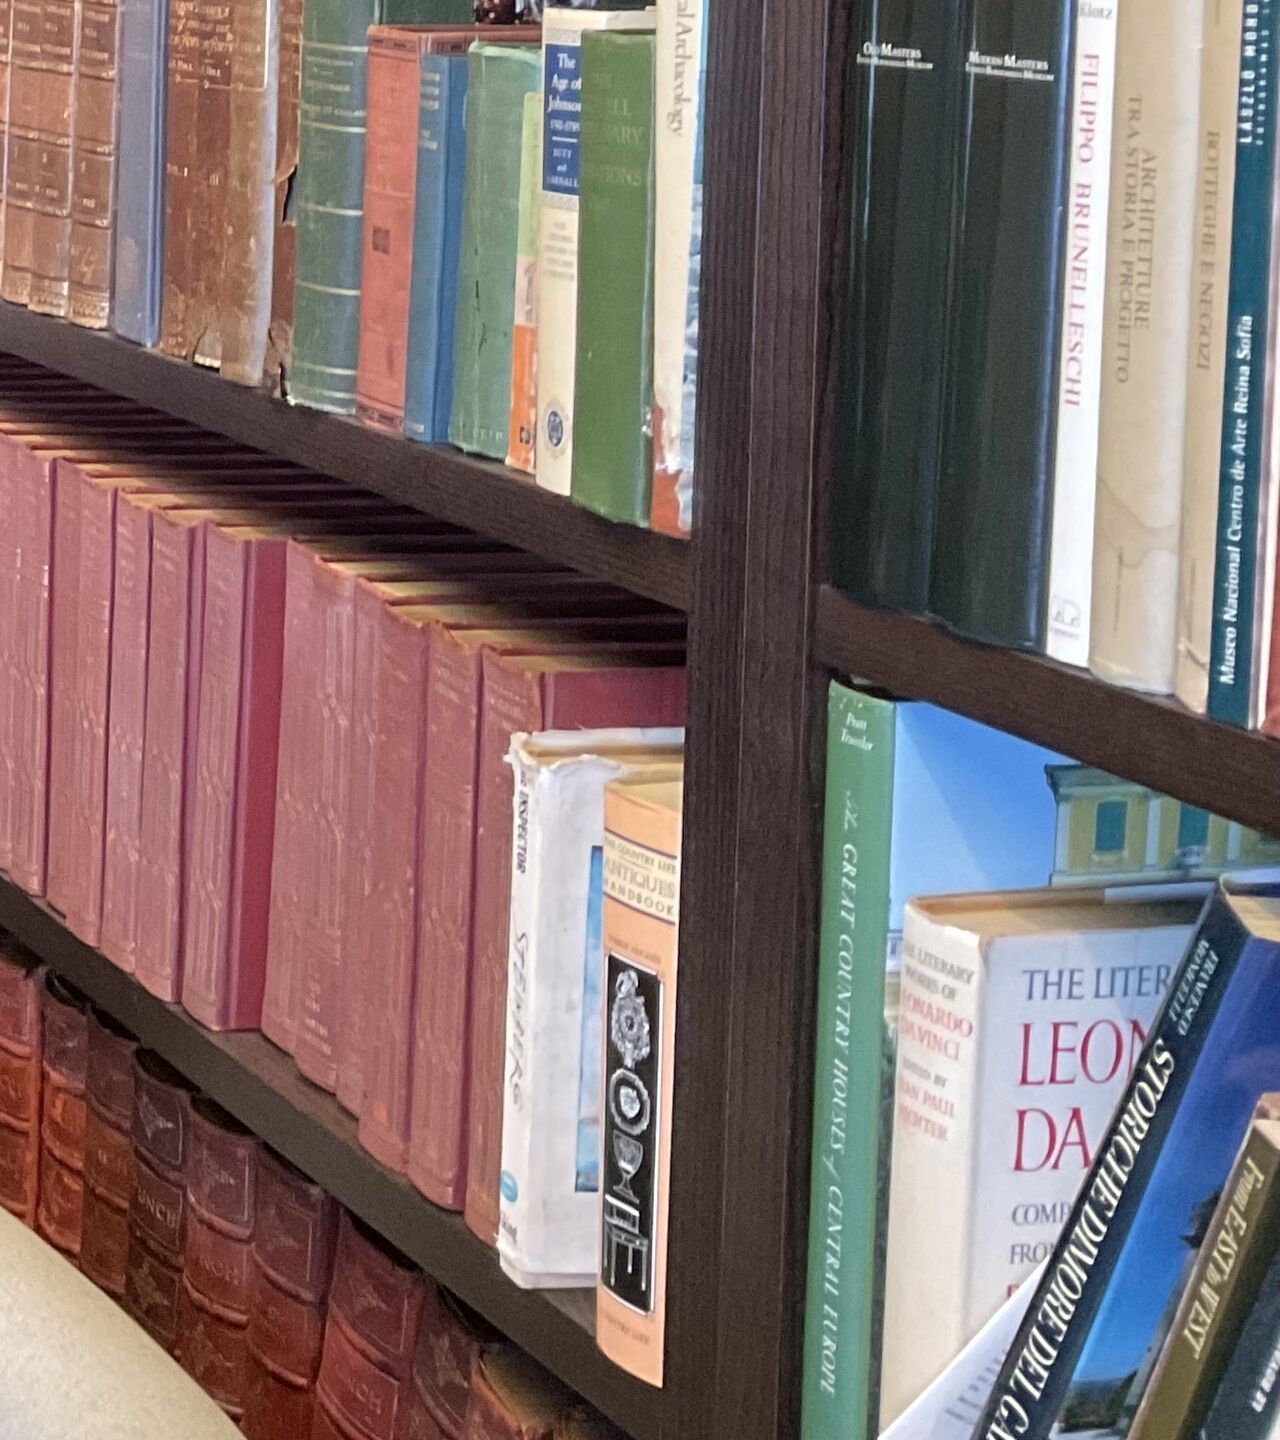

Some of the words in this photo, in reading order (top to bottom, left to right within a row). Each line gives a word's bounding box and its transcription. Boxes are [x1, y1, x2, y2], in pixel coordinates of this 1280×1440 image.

[552, 73, 570, 92] Age
[557, 53, 576, 70] The
[668, 20, 693, 137] Archaeology
[1075, 52, 1100, 164] FILIPPO
[1128, 95, 1143, 142] TRA
[1122, 145, 1139, 233] STORIA
[1201, 131, 1220, 246] BOTTEGHE
[1133, 147, 1157, 331] ARCHITETTURE
[1063, 182, 1092, 408] BRUNELLESCHI
[1116, 258, 1135, 385] PROGETTO
[1195, 279, 1214, 371] NEGOZI
[1231, 365, 1251, 415] Reina
[1226, 460, 1245, 481] de
[1228, 420, 1248, 456] Arte
[1226, 484, 1244, 541] Centro
[1218, 546, 1241, 623] Nacional
[1217, 627, 1238, 685] Museo
[516, 790, 530, 875] INSPECTOR
[838, 842, 859, 923] GREAT
[831, 933, 855, 1053] COUNTRY
[1023, 967, 1085, 1001] THE
[917, 1020, 961, 1063] VINCI
[828, 1060, 850, 1151] HOUSES
[1013, 1106, 1094, 1173] DA
[1091, 1037, 1175, 1219] STORICHE
[823, 1185, 844, 1296] CENTRAL
[1037, 1203, 1108, 1343] DIMORE
[1210, 1206, 1247, 1280] EAST
[820, 1306, 840, 1399] EUROPE
[1182, 1284, 1220, 1360] WEST
[1009, 1327, 1059, 1402] DEL
